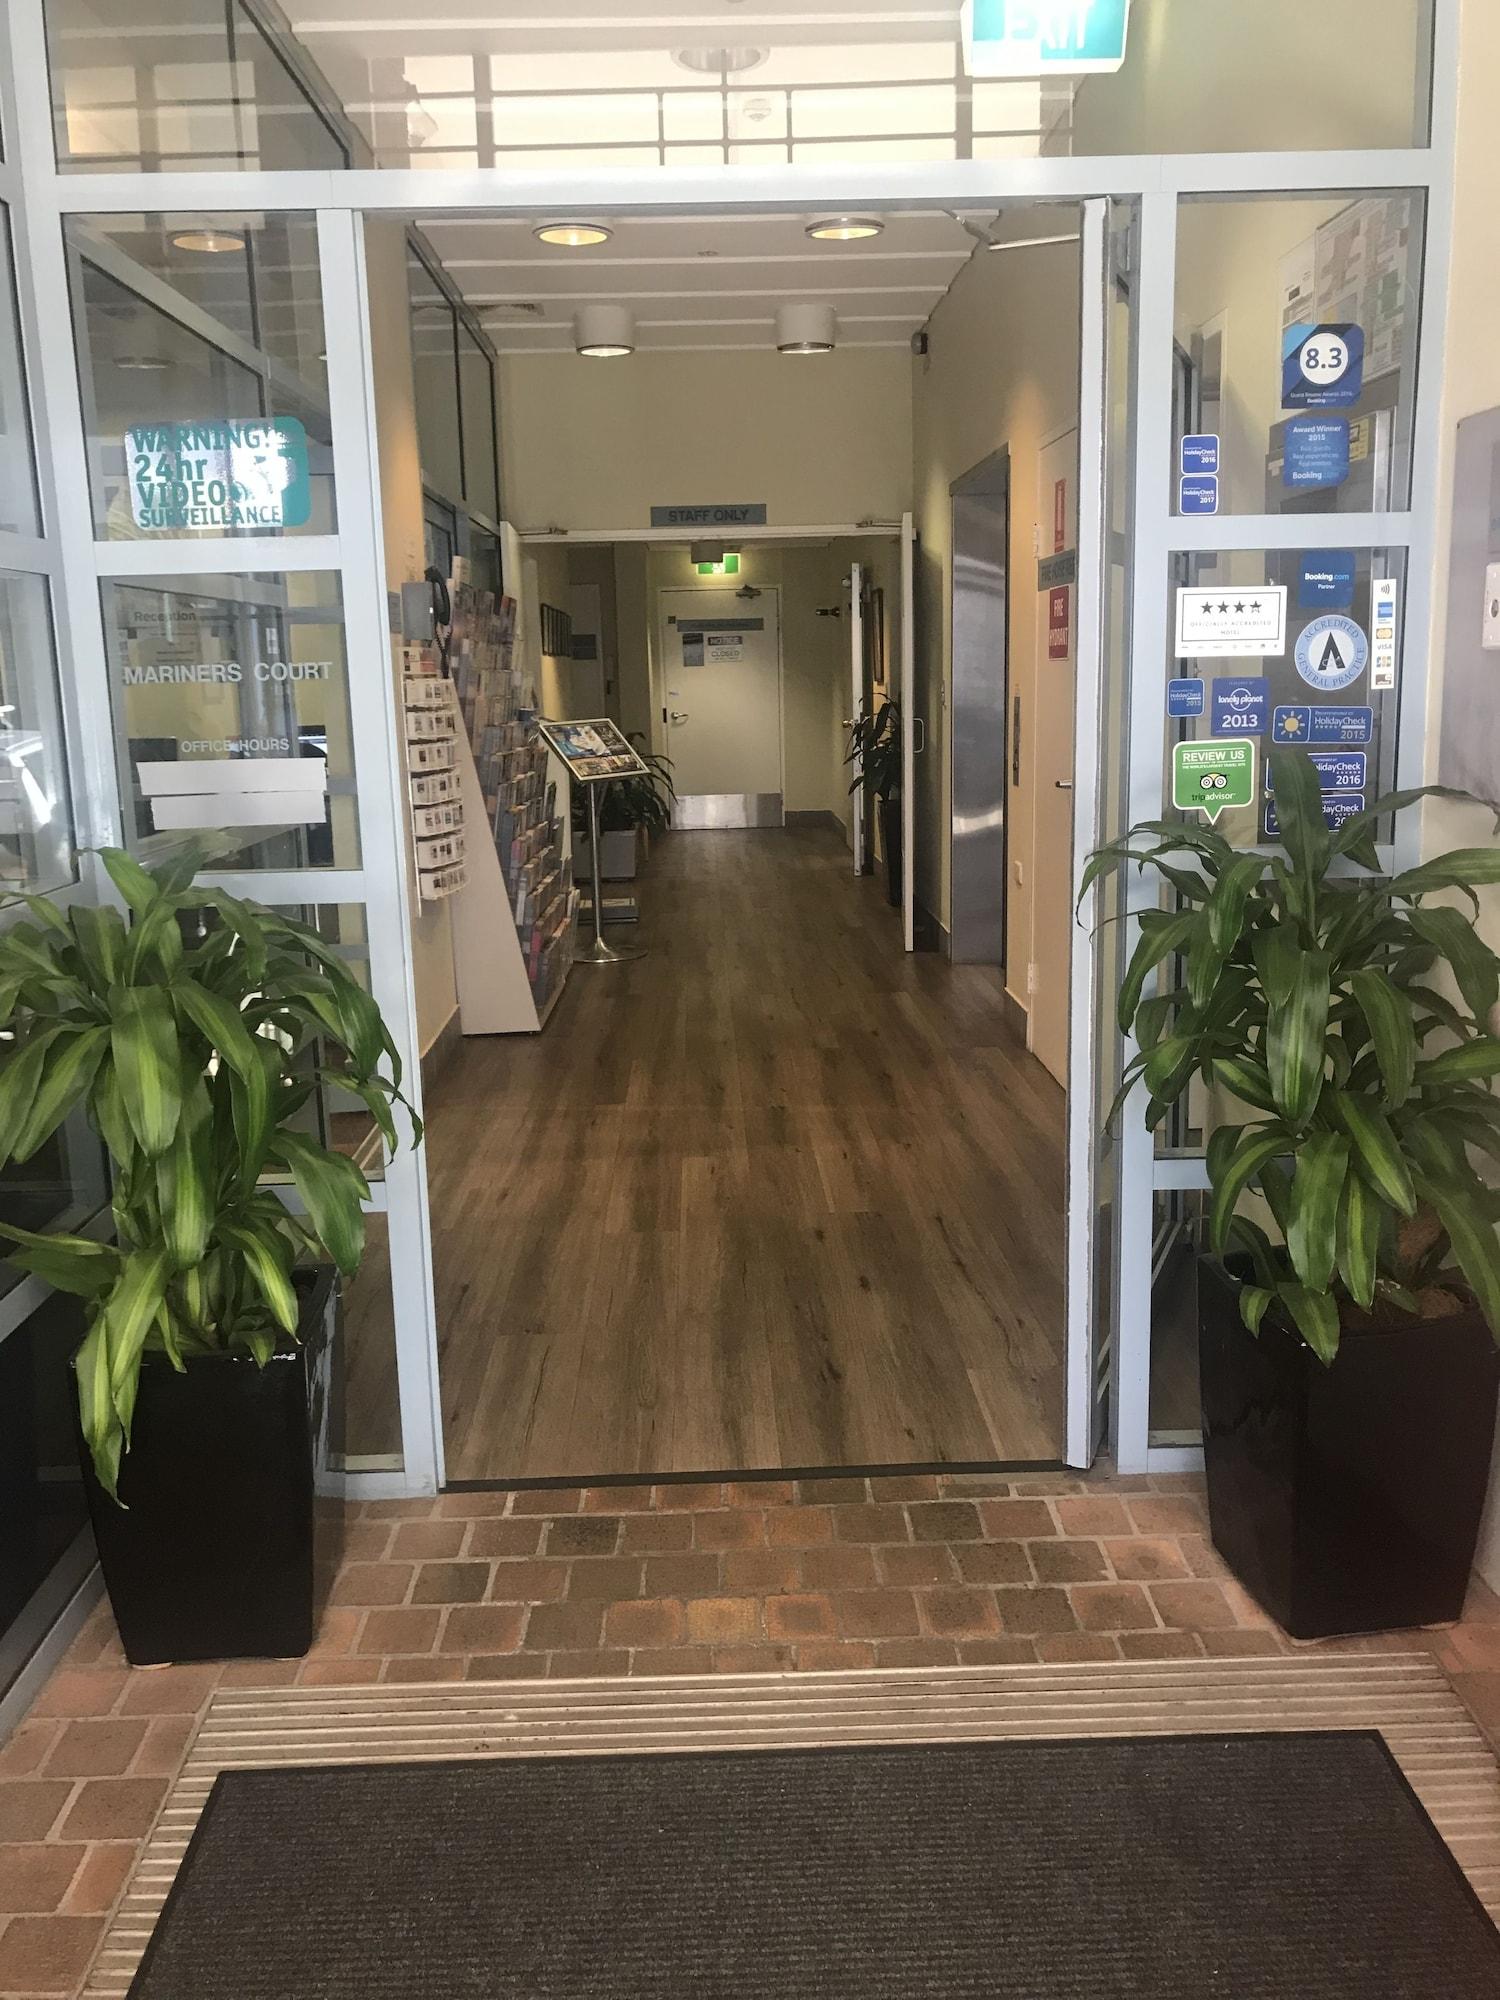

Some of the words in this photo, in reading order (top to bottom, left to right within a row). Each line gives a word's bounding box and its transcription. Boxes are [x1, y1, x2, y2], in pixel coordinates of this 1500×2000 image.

[1305, 347, 1342, 369] 8.3
[1293, 425, 1316, 433] Award
[1316, 424, 1342, 432] Winner
[131, 423, 271, 452] WARNING!
[1307, 433, 1326, 441] 2015
[1201, 456, 1216, 464] 2016
[134, 453, 208, 482] 24hr
[136, 480, 226, 508] VIDEO
[1183, 489, 1214, 497] HolidayCheck
[139, 505, 281, 528] SURVEILLANCE
[668, 510, 710, 523] STAFF
[713, 508, 749, 521] ONLY
[1305, 572, 1349, 581] Booking.com
[1054, 598, 1064, 617] FIRE
[134, 611, 196, 622] Recetion
[1304, 618, 1359, 642] ACCREDITED
[124, 663, 242, 685] MARINERS
[254, 661, 332, 682] COURT
[1298, 652, 1328, 687] GENERAL
[1332, 646, 1365, 687] PRACTICE
[1218, 694, 1240, 705] lonely
[1240, 694, 1263, 706] planet
[1222, 714, 1258, 728] 2013
[1314, 716, 1366, 727] HolidayCheck
[1340, 730, 1365, 740] 2015
[180, 739, 232, 753] OFFICE
[239, 738, 290, 752] HOURS
[1183, 751, 1226, 763] REVIEW
[1230, 749, 1245, 760] US
[1316, 762, 1361, 773] lidayCheck
[1336, 775, 1360, 785] 2016
